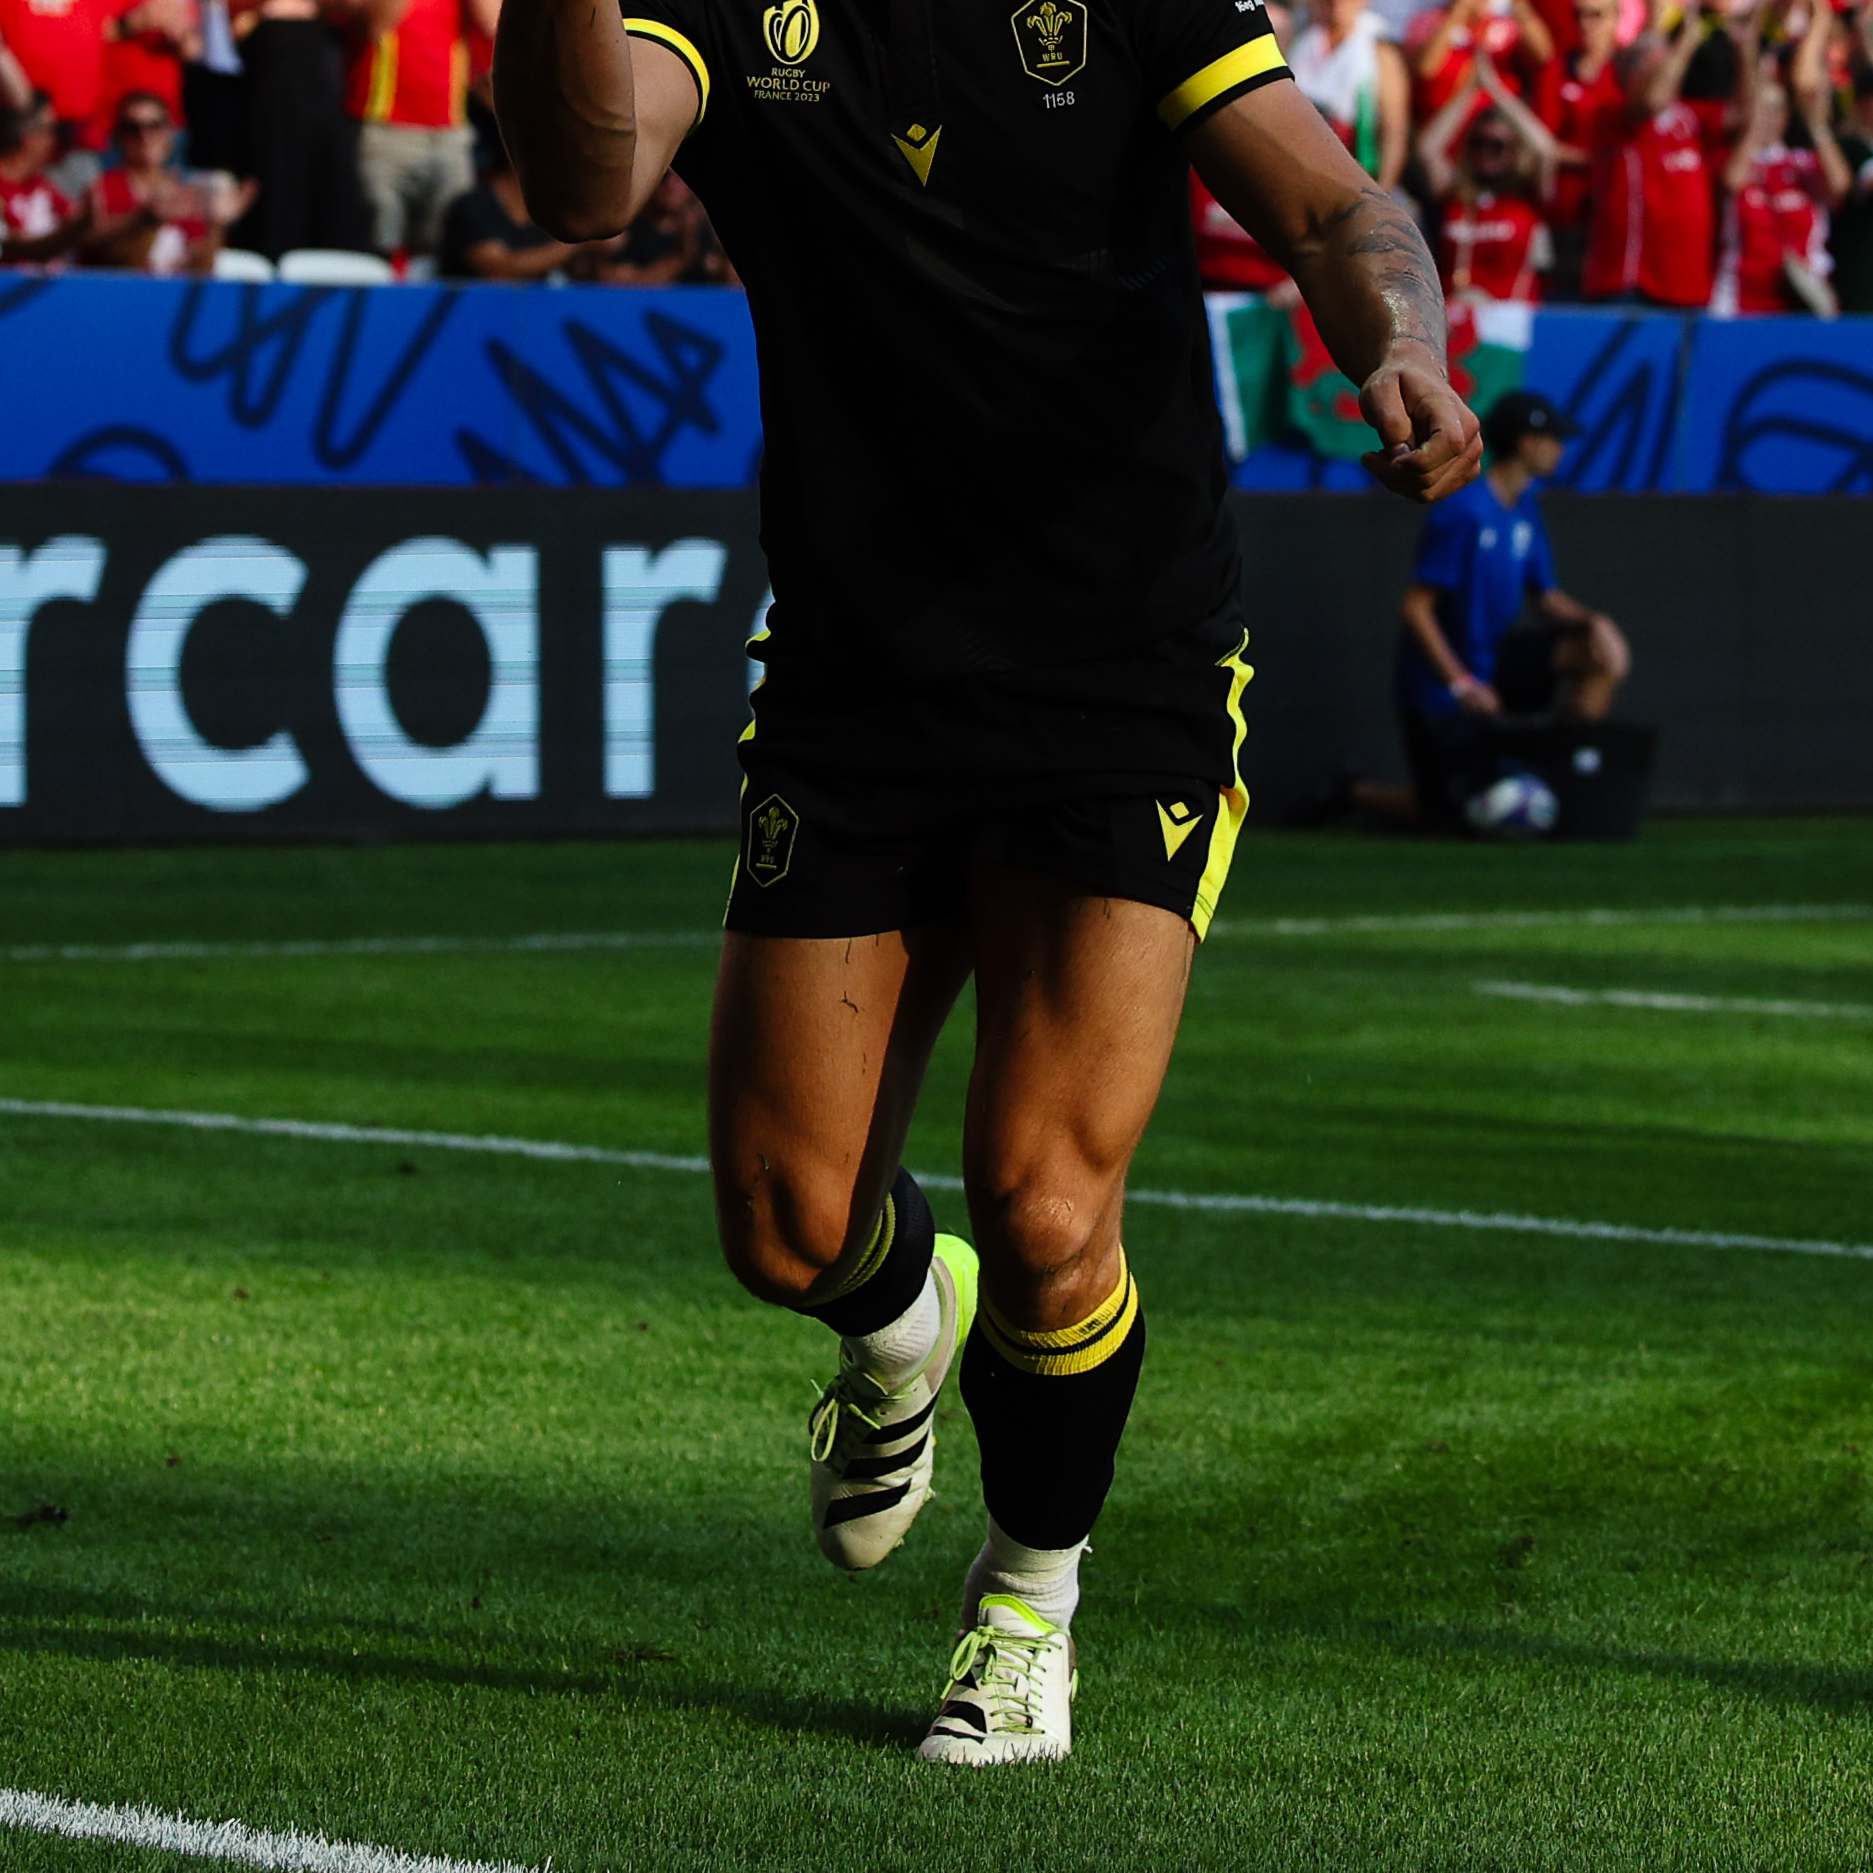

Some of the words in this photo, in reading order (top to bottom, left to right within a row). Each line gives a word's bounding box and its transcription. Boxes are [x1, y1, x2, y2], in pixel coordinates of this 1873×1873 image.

[1042, 51, 1063, 62] WRU
[771, 67, 806, 78] RUGBY
[746, 76, 800, 91] WORLD
[802, 80, 831, 93] CUP
[754, 89, 792, 101] FRANCE
[794, 92, 820, 102] 2023
[1042, 91, 1075, 109] 1158
